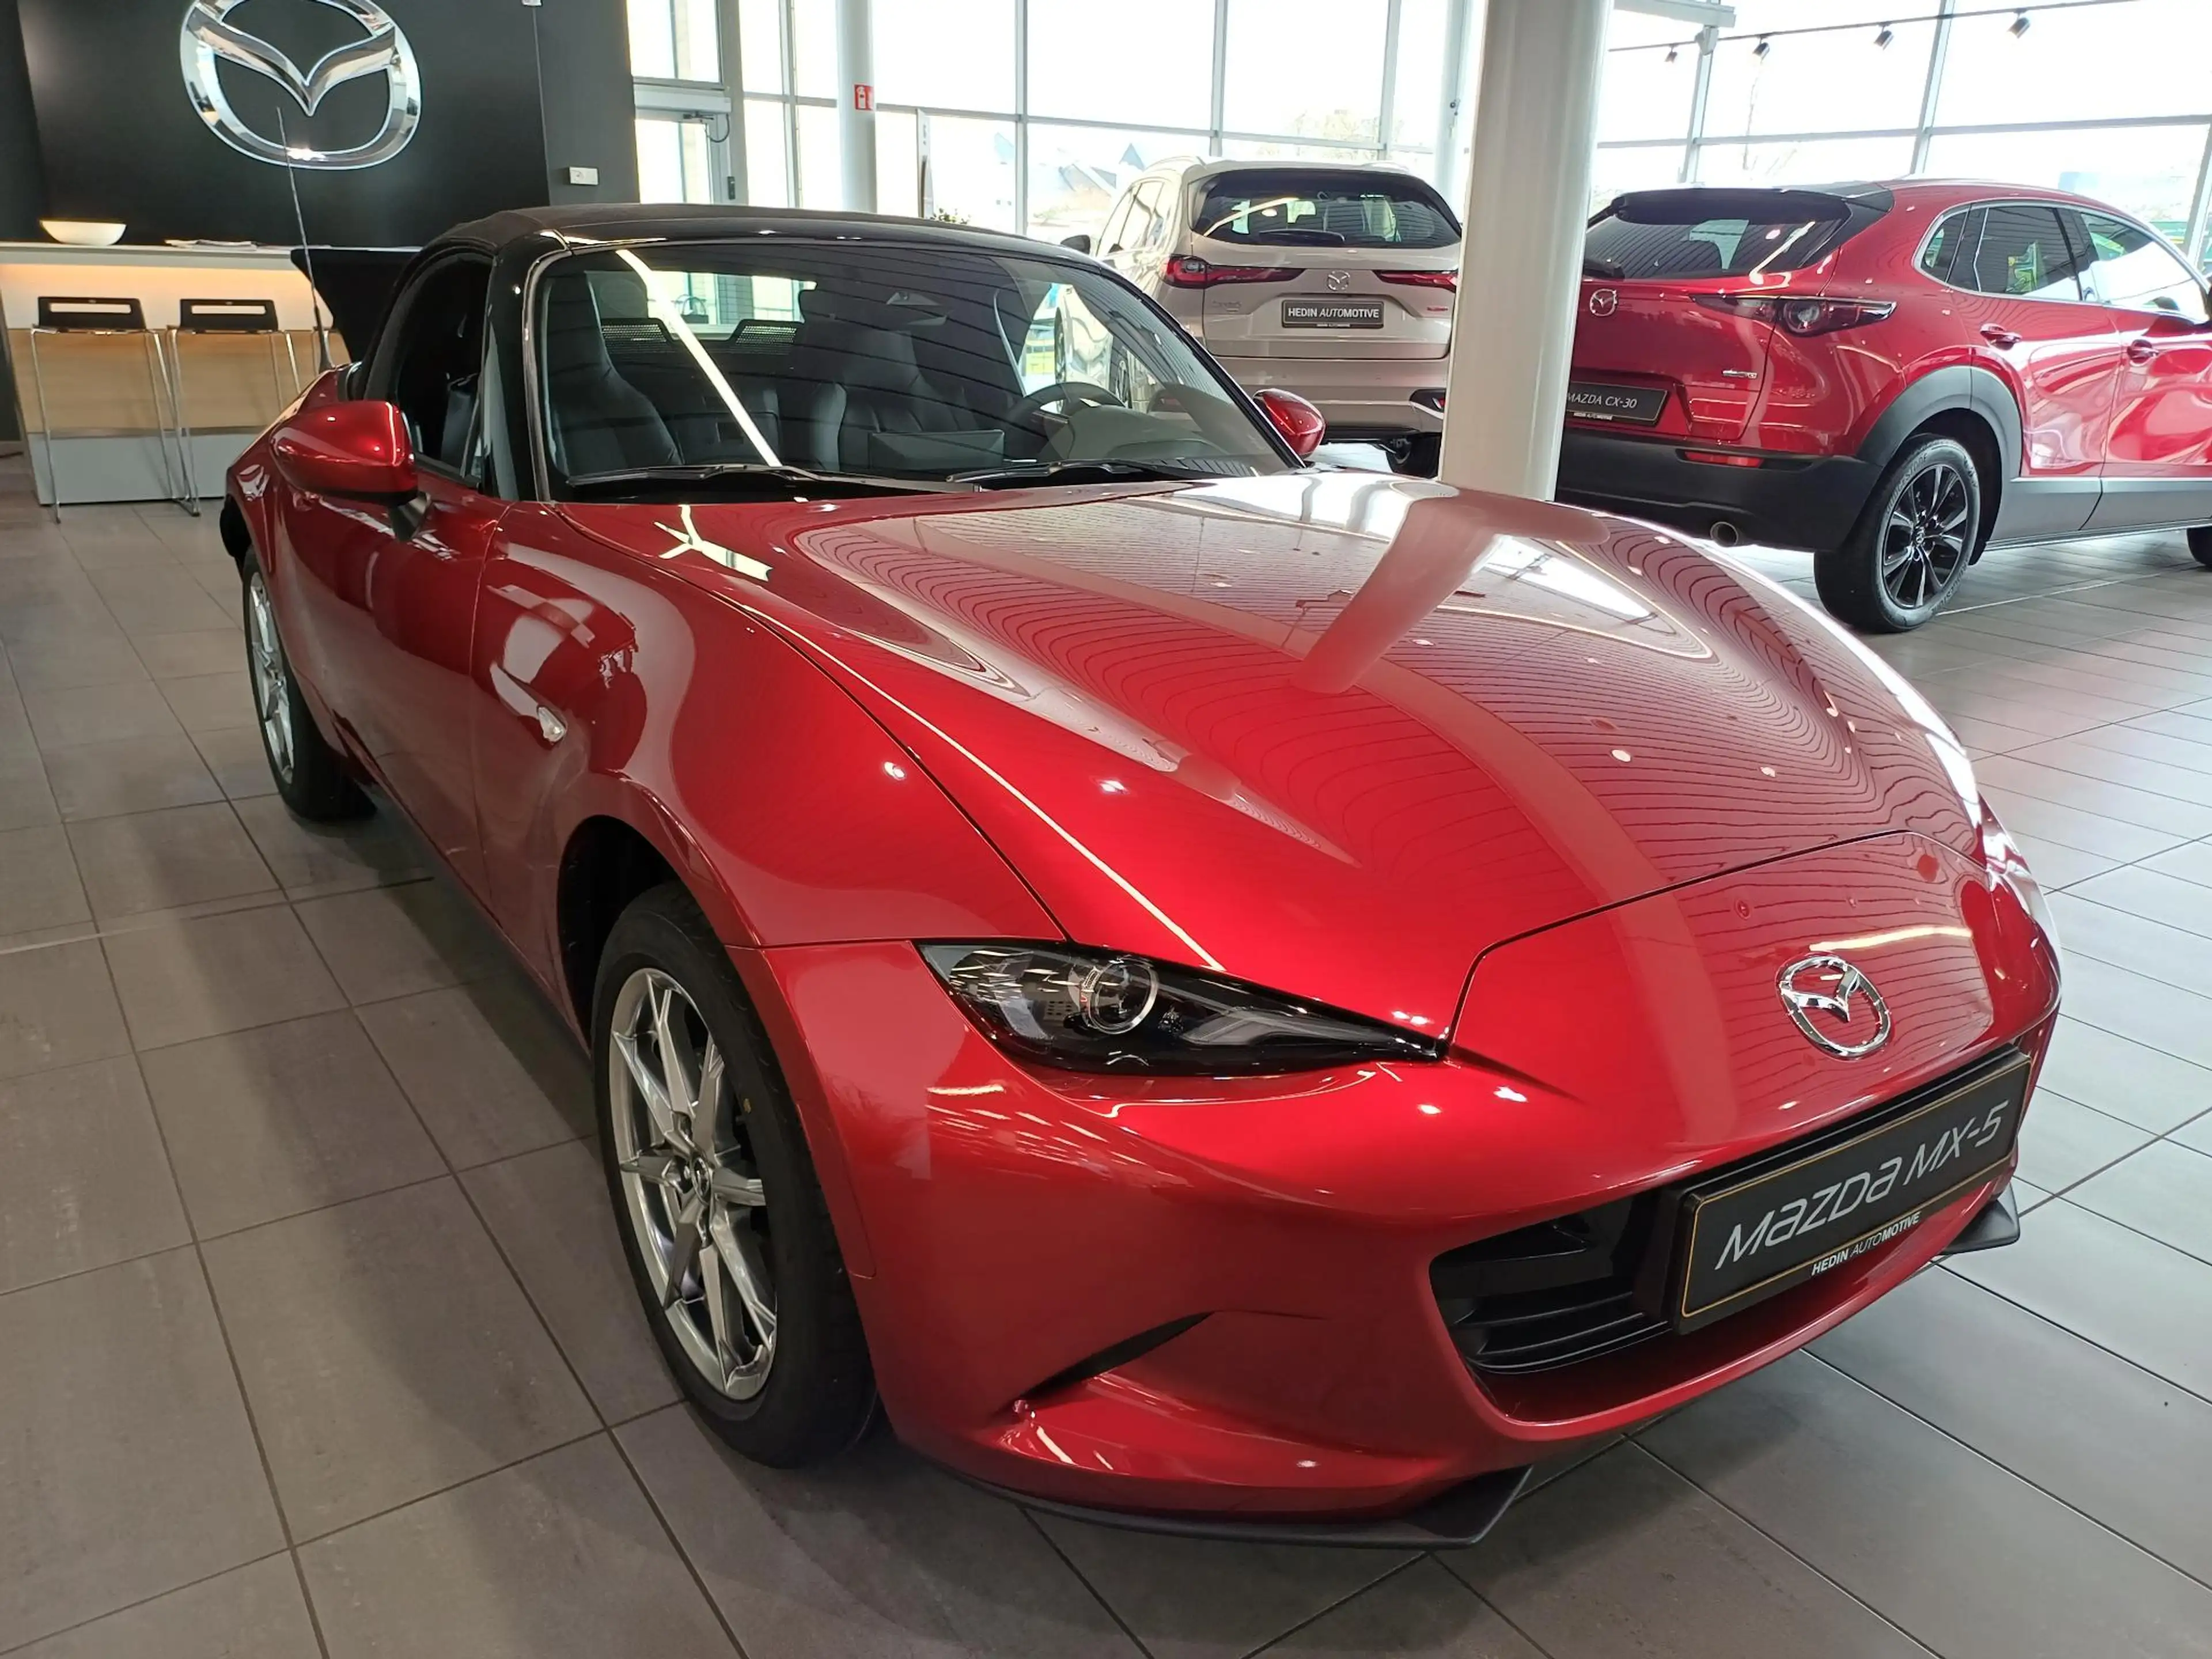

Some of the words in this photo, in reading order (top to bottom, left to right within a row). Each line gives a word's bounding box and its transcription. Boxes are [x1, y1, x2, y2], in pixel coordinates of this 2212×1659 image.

[1288, 308, 1317, 316] HEDIN
[1319, 308, 1379, 317] AUTOMOTIVE
[1605, 396, 1637, 408] CX-30
[1903, 1100, 2010, 1186] MX-5
[1810, 1247, 1849, 1276] HEDIN
[1850, 1210, 1922, 1258] AUTOMOTIVE
